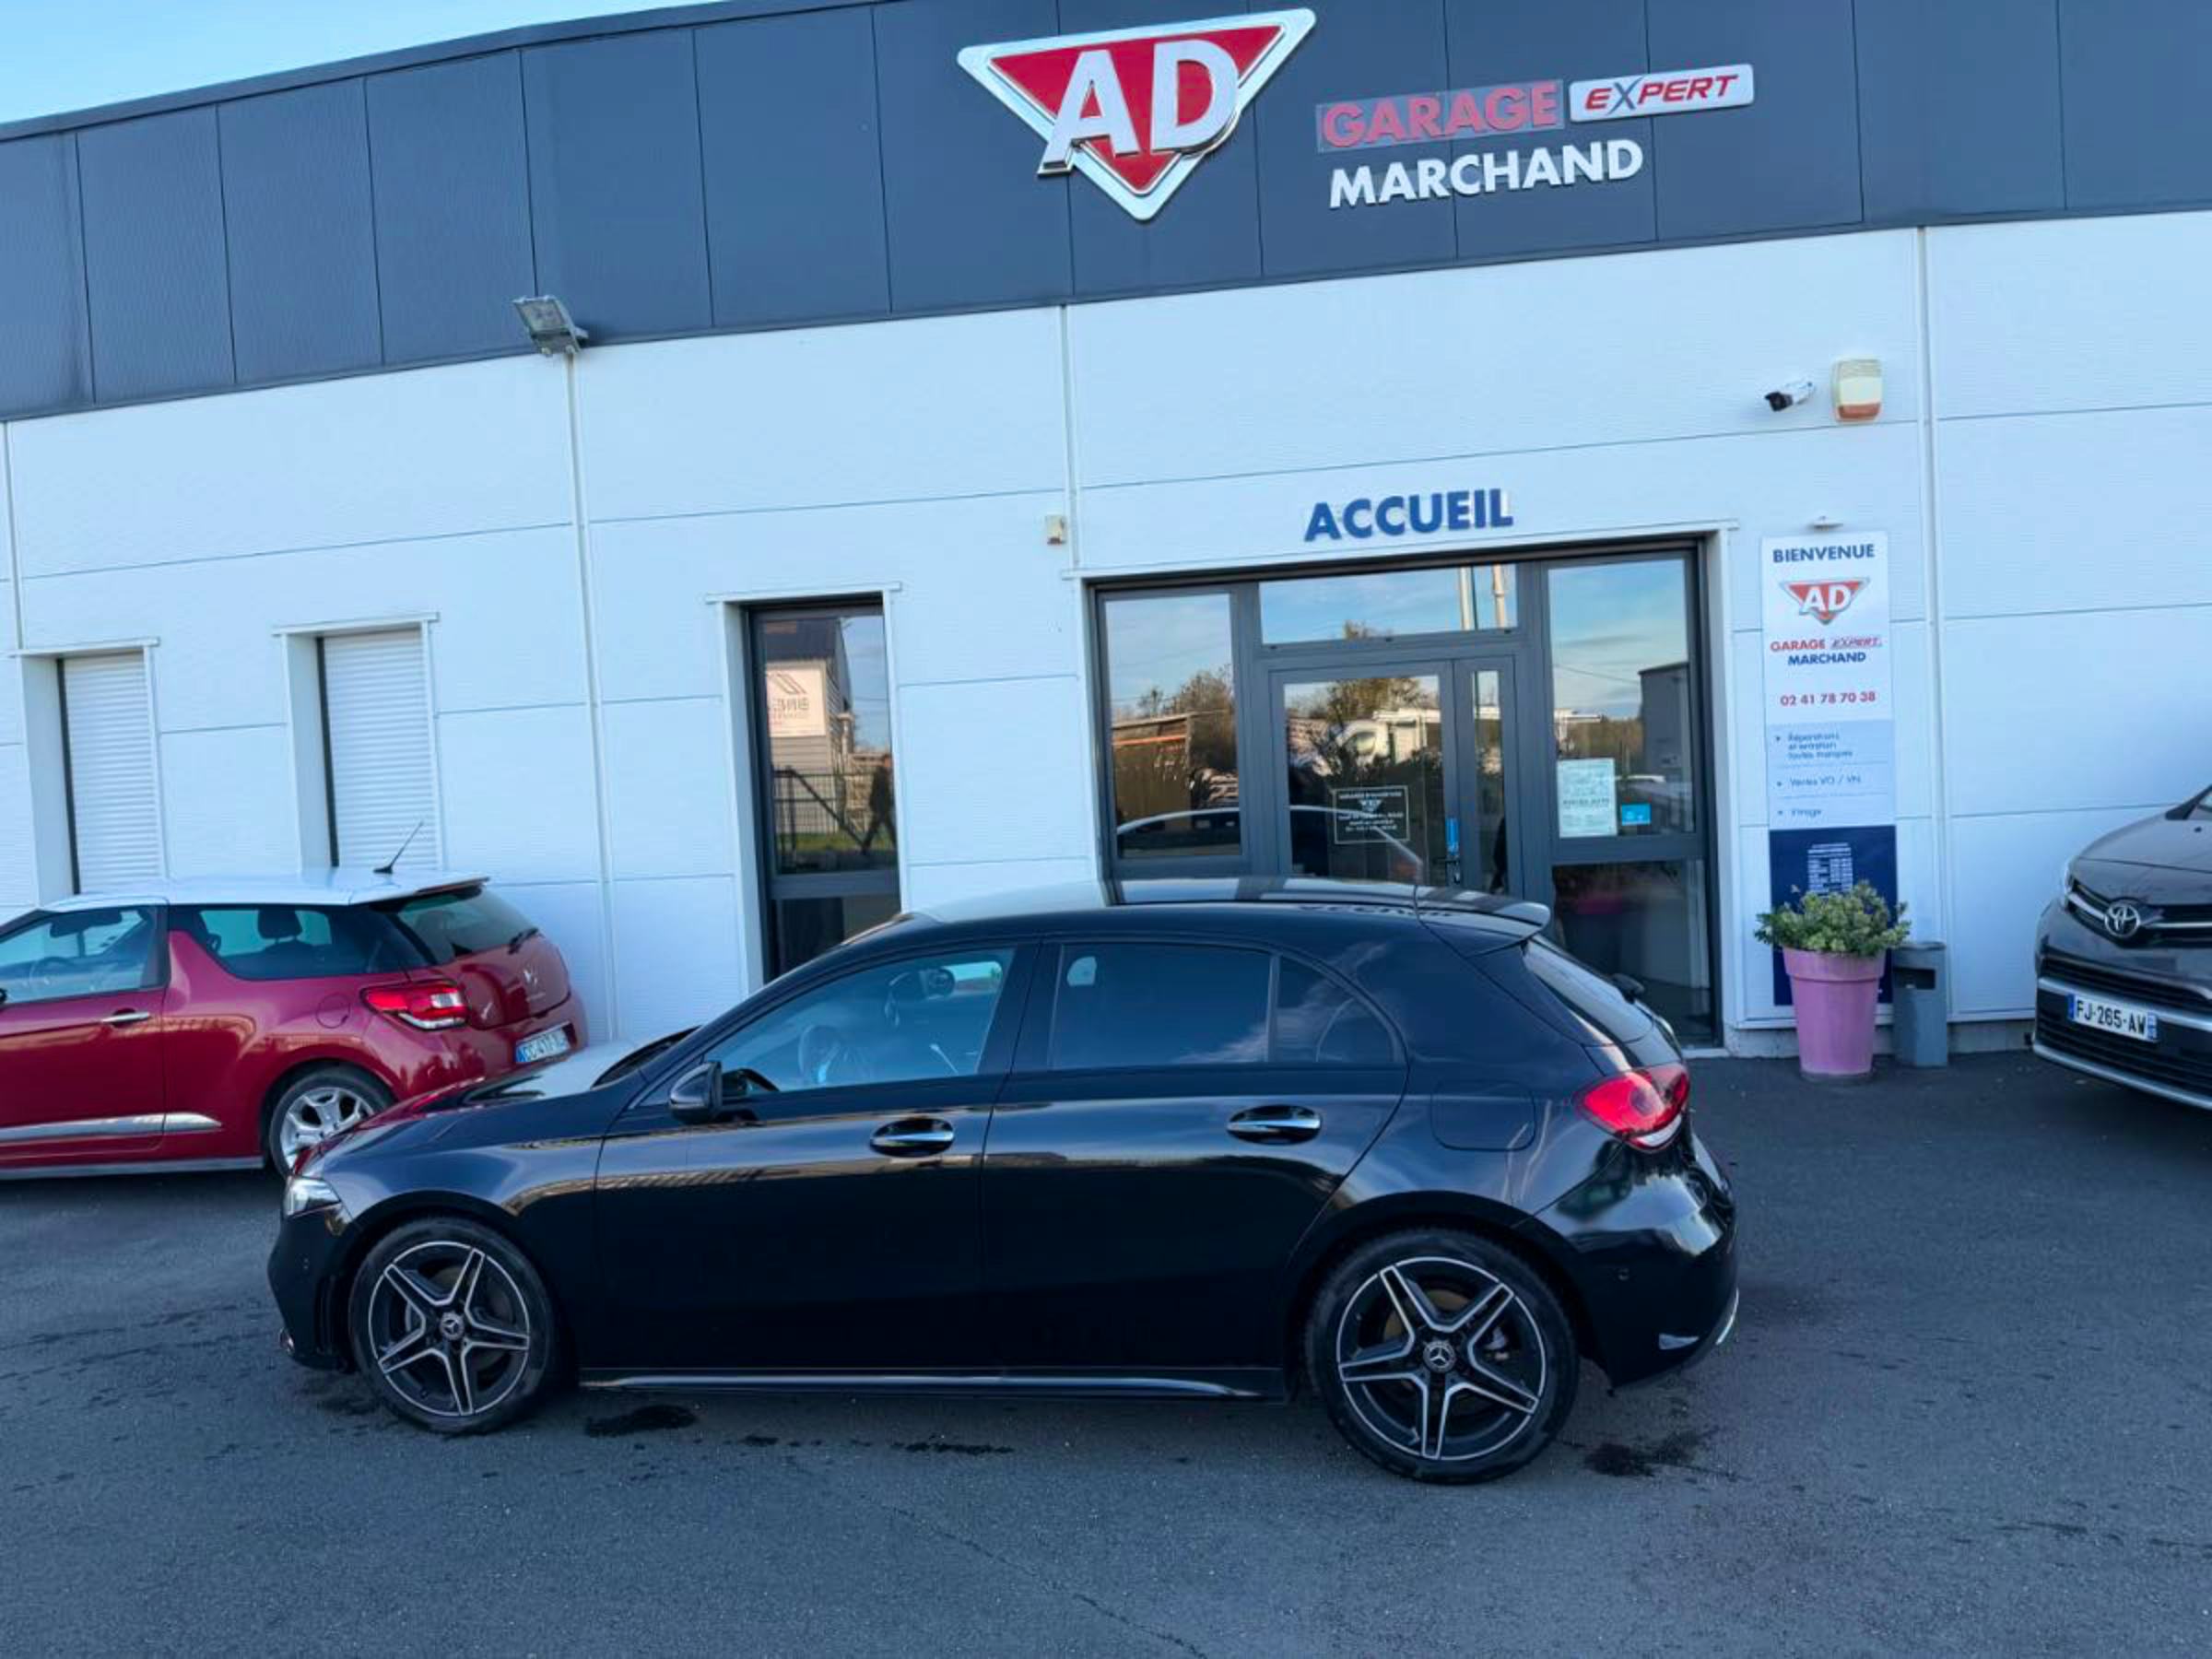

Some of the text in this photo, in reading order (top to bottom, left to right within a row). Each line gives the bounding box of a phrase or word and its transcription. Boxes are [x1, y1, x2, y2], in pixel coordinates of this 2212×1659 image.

[1039, 40, 1241, 174] AD
[1323, 74, 1740, 147] GARAGE EXPERT
[1329, 138, 1643, 208] MARCHAND
[1304, 488, 1514, 542] ACCUEIL
[1772, 544, 1876, 563] BIENVENUE
[1799, 584, 1851, 615] AD
[1770, 639, 1826, 652] GARAGE
[1787, 652, 1866, 665] MARCHAND
[1780, 694, 1797, 707] 02
[1800, 693, 1815, 705] 41
[1820, 692, 1836, 704] 78
[1840, 691, 1856, 703] 70
